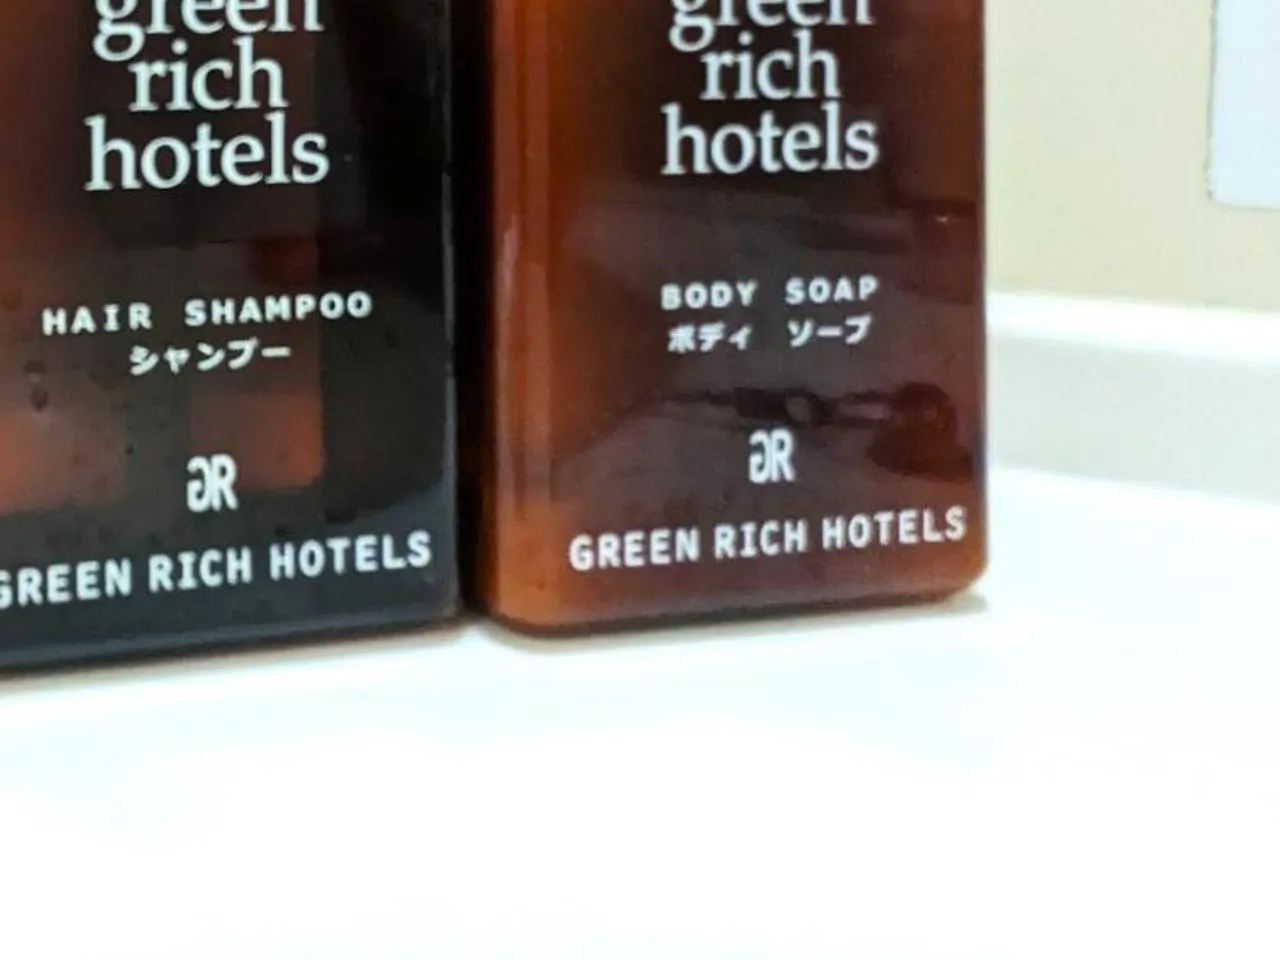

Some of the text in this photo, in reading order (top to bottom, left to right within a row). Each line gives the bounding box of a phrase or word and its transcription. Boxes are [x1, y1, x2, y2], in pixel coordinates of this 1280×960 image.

[125, 35, 288, 112] rich
[696, 27, 841, 100] rich
[86, 110, 329, 191] hotels
[662, 100, 879, 175] hotels
[42, 291, 372, 336] HAIR SHAMPOO
[661, 275, 878, 310] BODY SOAP
[148, 547, 252, 592] RICH
[270, 530, 432, 580] HOTELS
[568, 505, 965, 571] GREEN RICH HOTELS
